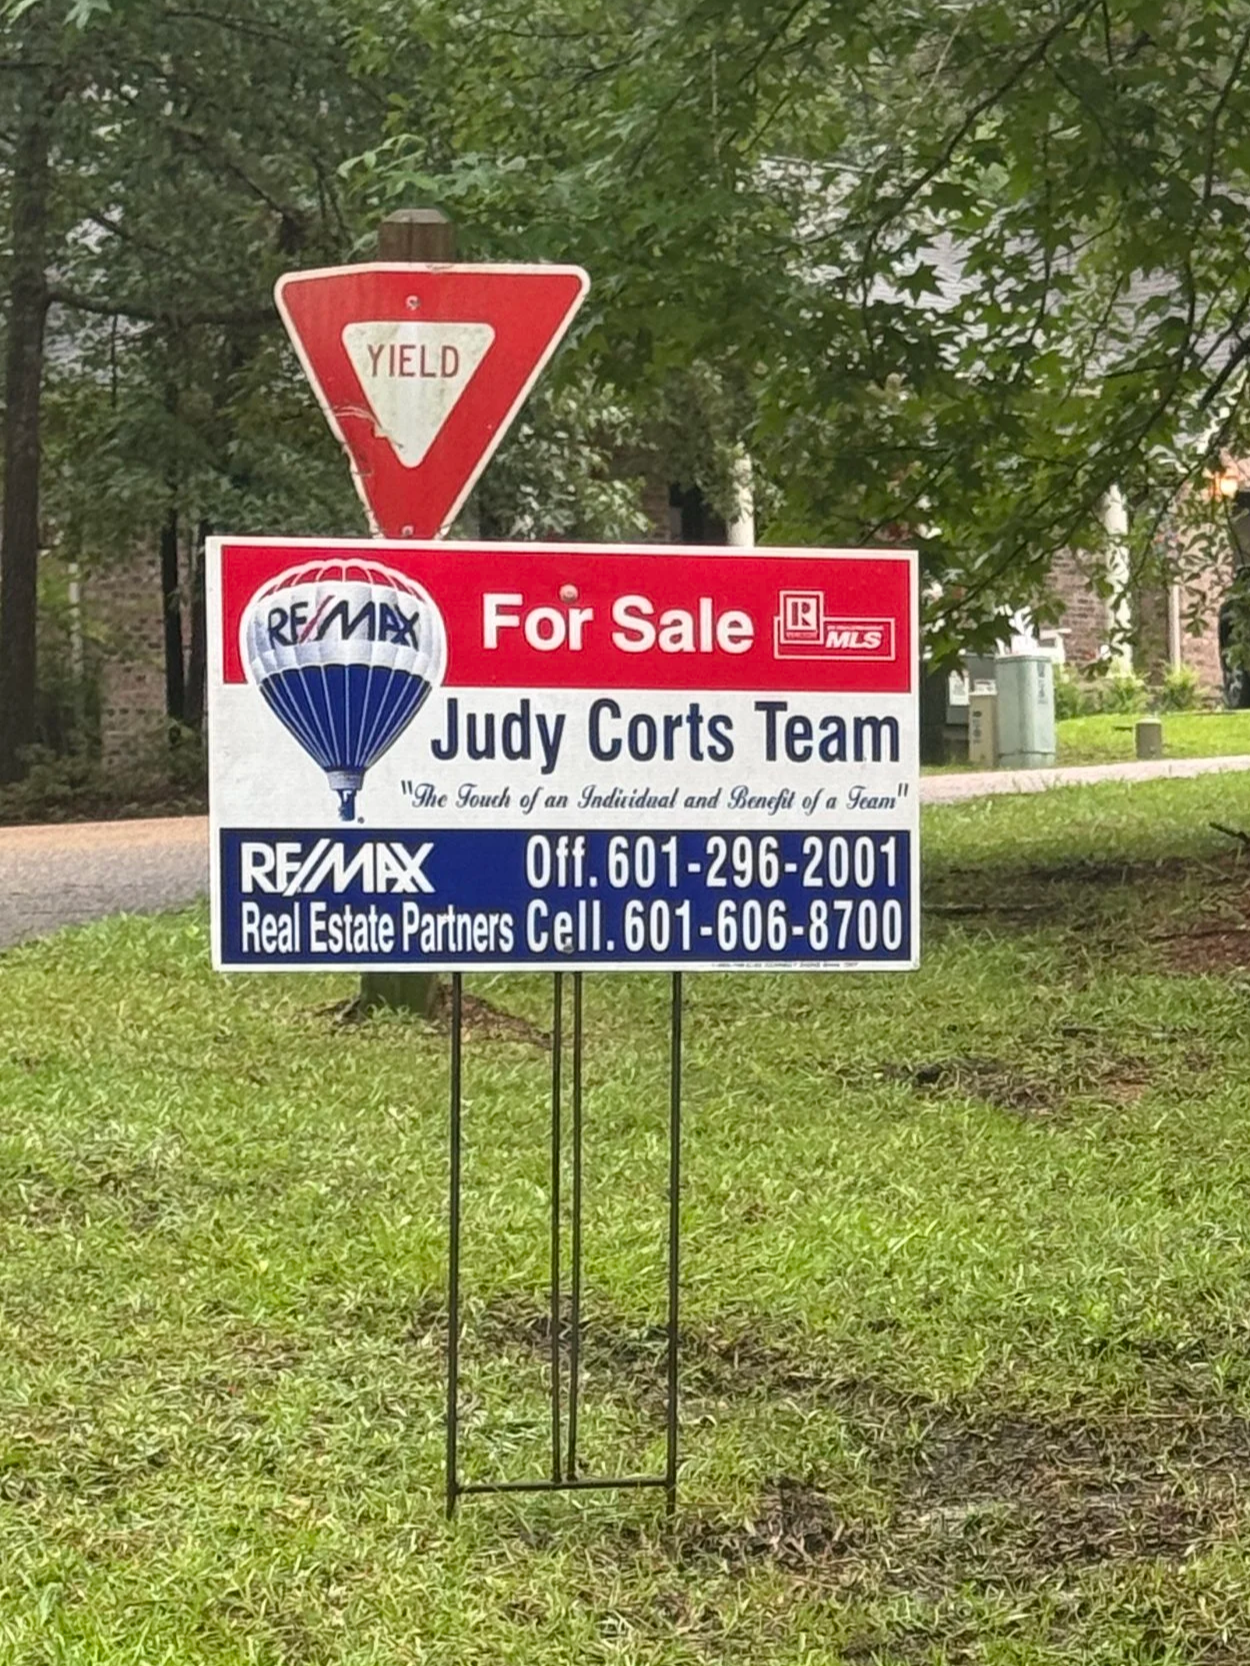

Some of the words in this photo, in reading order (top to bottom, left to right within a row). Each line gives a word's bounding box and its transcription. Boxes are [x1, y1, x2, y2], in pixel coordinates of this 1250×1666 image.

[367, 344, 460, 378] YIELD
[267, 595, 420, 652] RE/MAX
[482, 592, 594, 651] For
[611, 594, 755, 654] Sale
[825, 630, 882, 650] MLS
[430, 697, 566, 775] Judy
[588, 697, 735, 762] Corts
[754, 700, 901, 763] Team
[455, 782, 512, 809] Touch
[519, 785, 544, 815] of
[544, 793, 569, 809] an
[577, 784, 680, 810] Individual
[683, 786, 723, 810] and
[727, 784, 797, 816] Benefit
[801, 786, 826, 817] of
[825, 795, 838, 810] a
[240, 837, 436, 897] RE/MAX
[241, 900, 301, 953] Real
[309, 901, 396, 953] Estate
[402, 901, 515, 953] Partners
